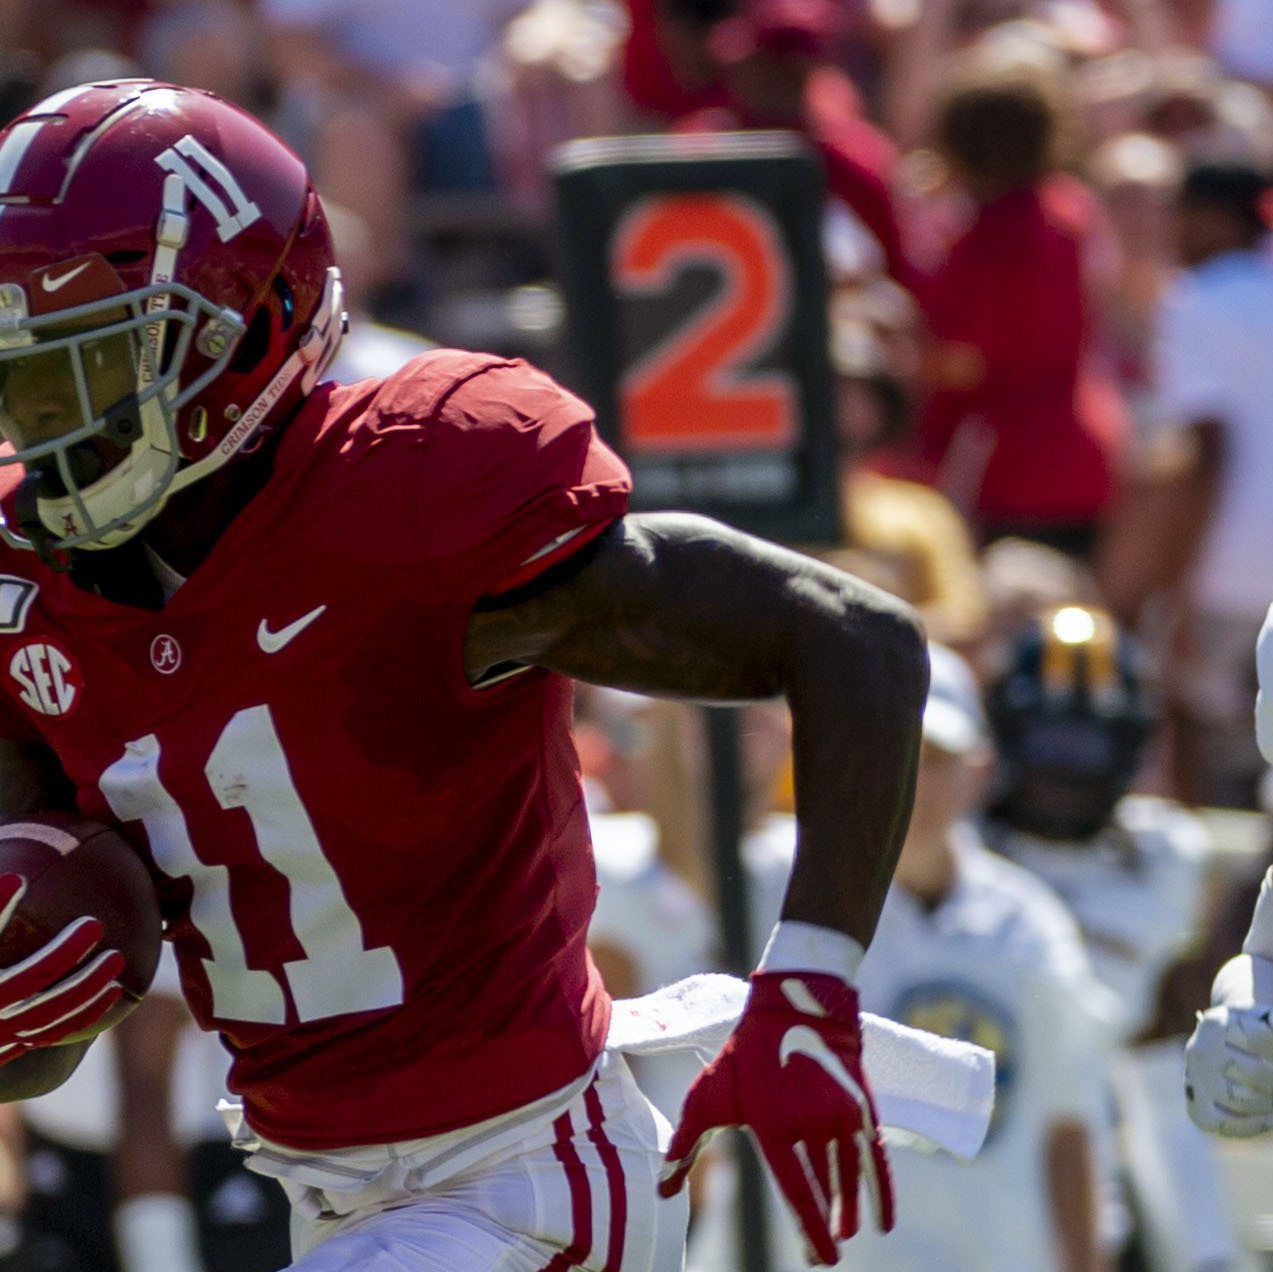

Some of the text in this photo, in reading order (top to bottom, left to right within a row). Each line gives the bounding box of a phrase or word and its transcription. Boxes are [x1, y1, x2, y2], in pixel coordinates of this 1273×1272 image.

[153, 134, 262, 243] 11
[612, 192, 798, 450] 2
[221, 399, 268, 455] CRIMSON
[9, 643, 76, 716] SEC
[98, 703, 404, 1026] 11
